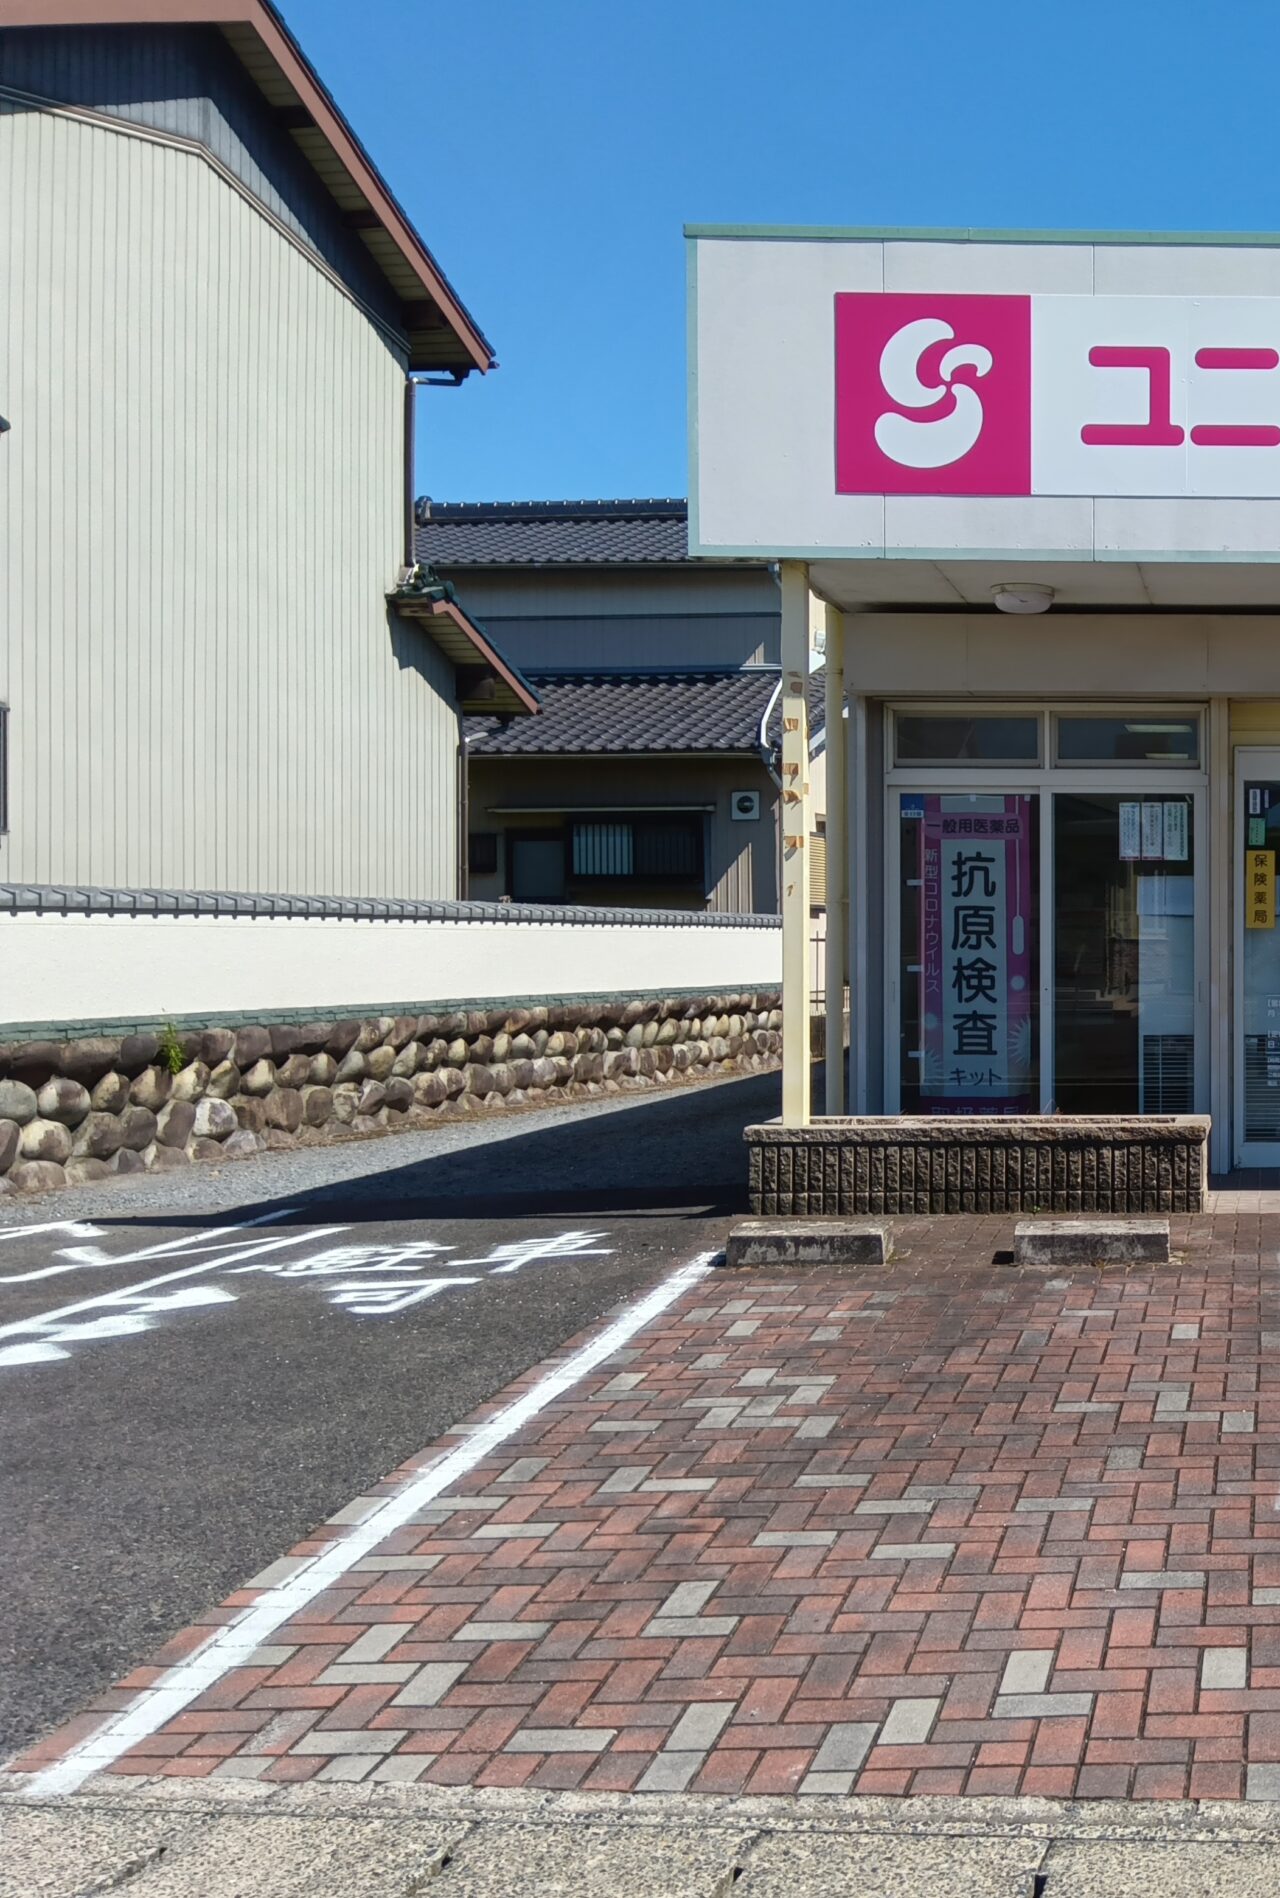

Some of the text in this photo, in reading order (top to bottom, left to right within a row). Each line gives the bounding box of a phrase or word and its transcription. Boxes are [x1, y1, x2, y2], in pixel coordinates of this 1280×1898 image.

[926, 818, 1020, 834] 一般用医薬品
[1253, 854, 1268, 924] 保険薬局
[925, 848, 939, 993] 新型コロナウイルス
[951, 851, 998, 1056] 抗原検査
[949, 1067, 1002, 1087] キット
[220, 1228, 617, 1277] 駐車
[324, 1276, 483, 1315] 可
